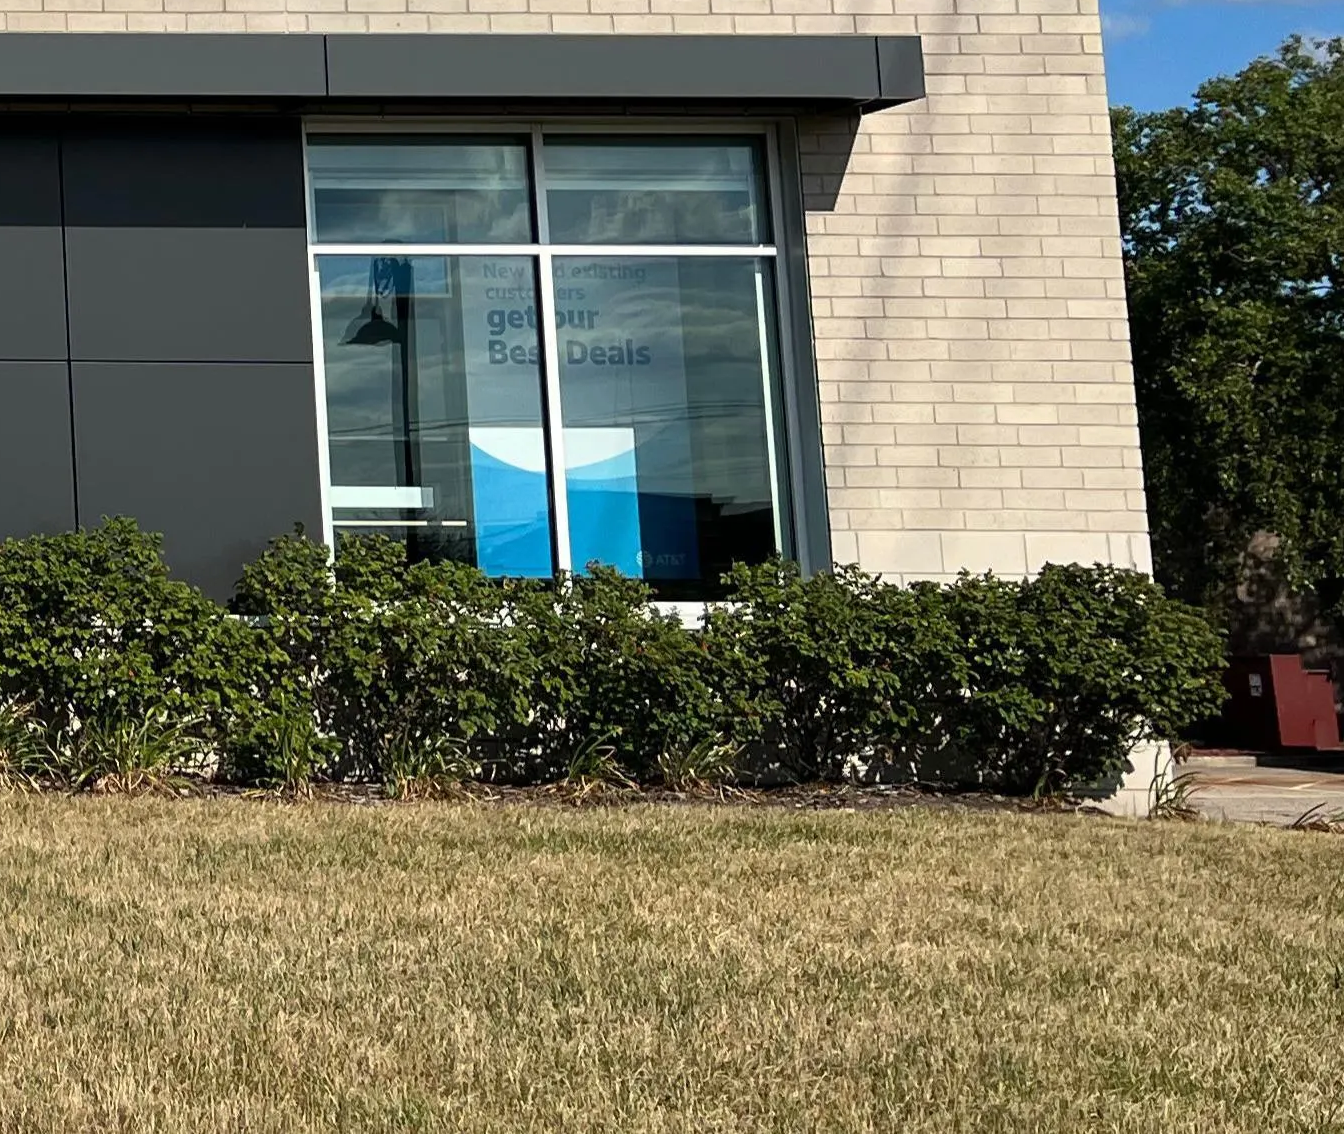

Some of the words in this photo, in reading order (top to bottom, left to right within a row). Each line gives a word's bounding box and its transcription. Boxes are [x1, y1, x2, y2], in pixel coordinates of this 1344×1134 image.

[483, 262, 525, 279] New
[572, 262, 646, 283] existing
[486, 285, 586, 300] custoers
[487, 305, 537, 336] get
[488, 339, 539, 365] Bes
[566, 338, 652, 366] Deals
